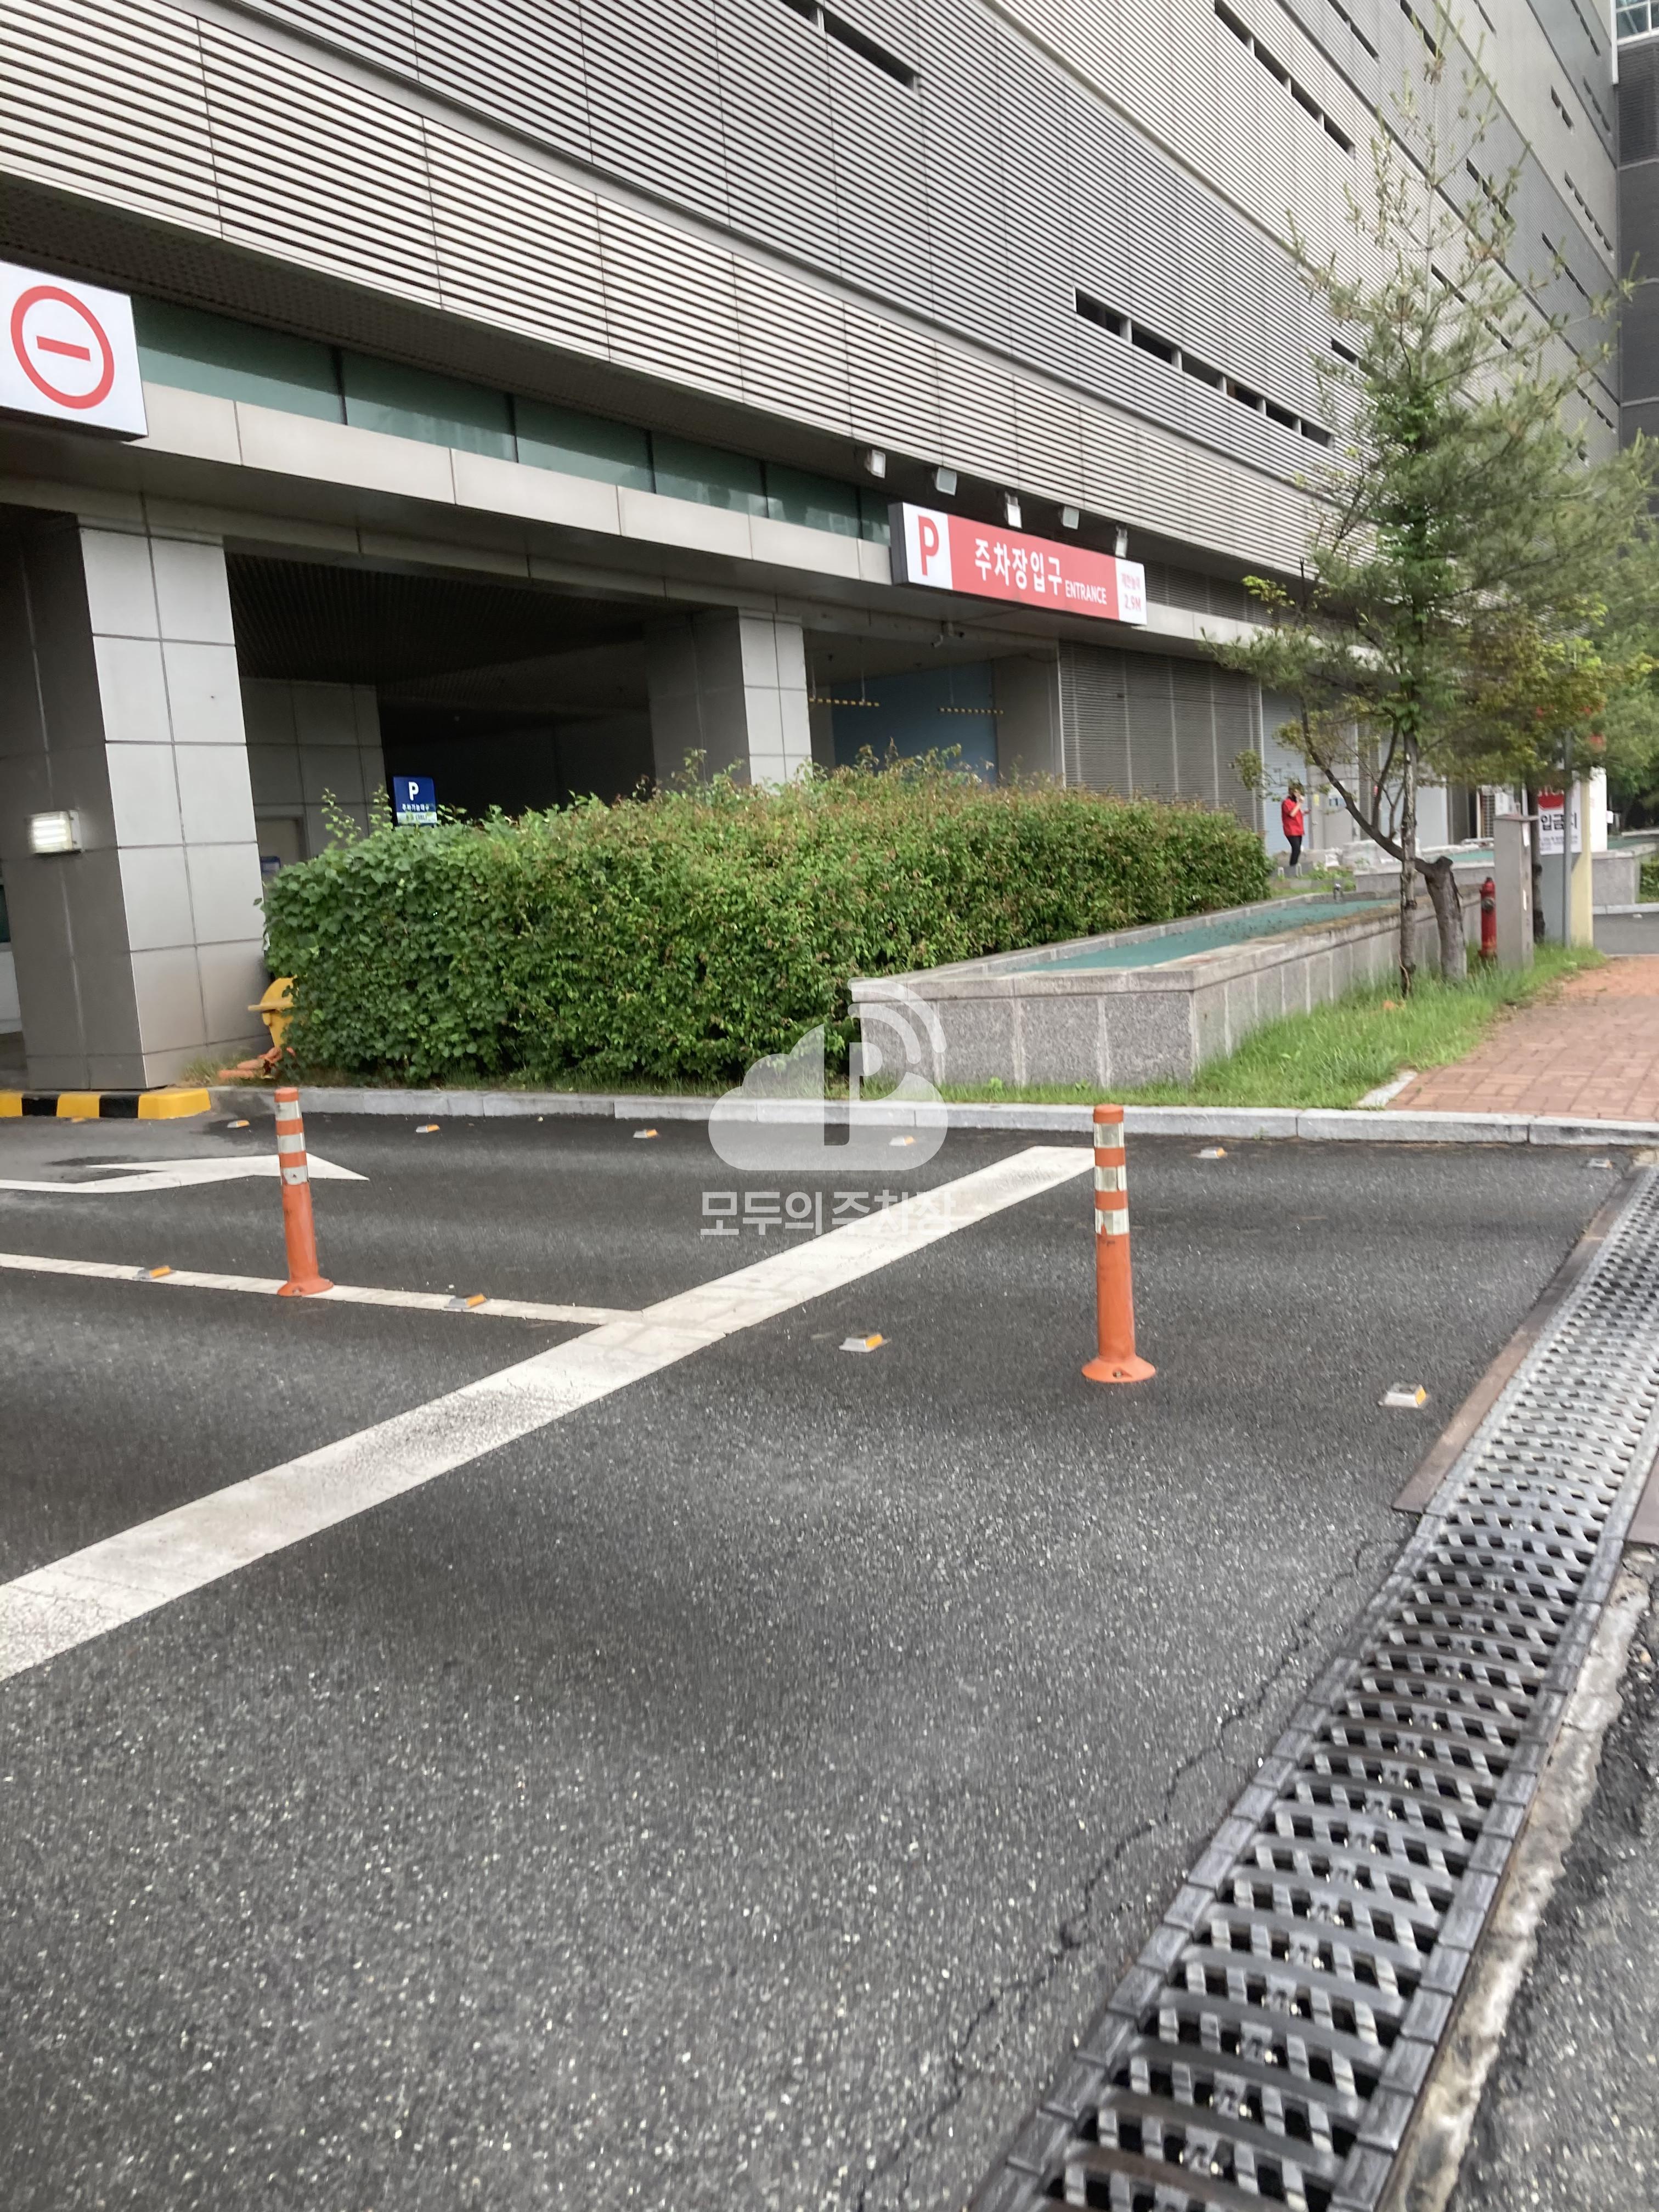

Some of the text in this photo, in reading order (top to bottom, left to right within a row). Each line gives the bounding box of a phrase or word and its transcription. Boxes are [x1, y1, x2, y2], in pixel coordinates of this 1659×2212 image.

[918, 514, 940, 577] P
[974, 538, 1063, 595] 주차장입구
[1065, 579, 1108, 605] ENTRANCE
[408, 781, 419, 801] P
